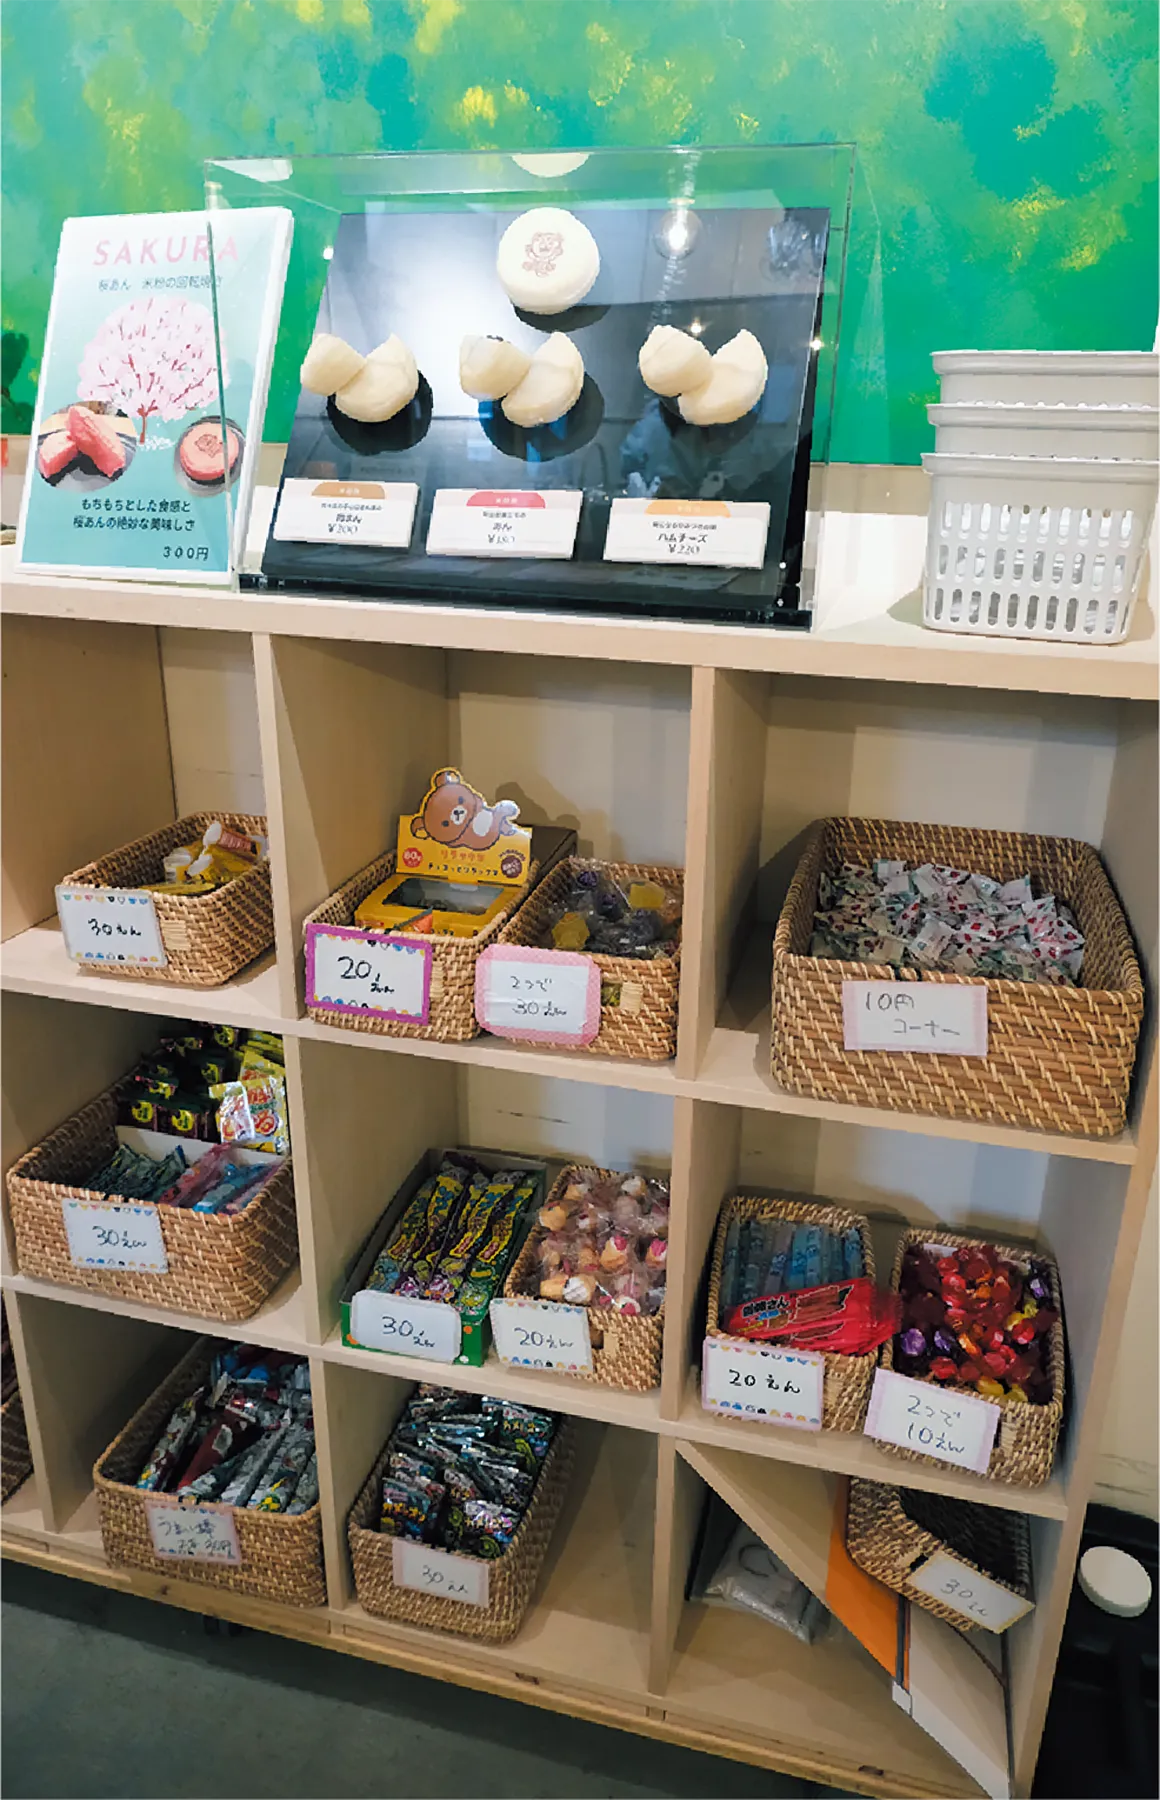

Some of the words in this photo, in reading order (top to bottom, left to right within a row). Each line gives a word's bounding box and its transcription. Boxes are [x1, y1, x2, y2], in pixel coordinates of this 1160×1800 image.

[92, 235, 239, 266] SAKURA
[82, 498, 191, 513] もちもちとした食感と
[73, 514, 196, 532] 桜あんの絶妙な美味しさ
[658, 533, 708, 543] ハムチーズ
[163, 546, 209, 561] 300円
[865, 991, 916, 1011] 10円
[893, 1019, 961, 1037] コーナー
